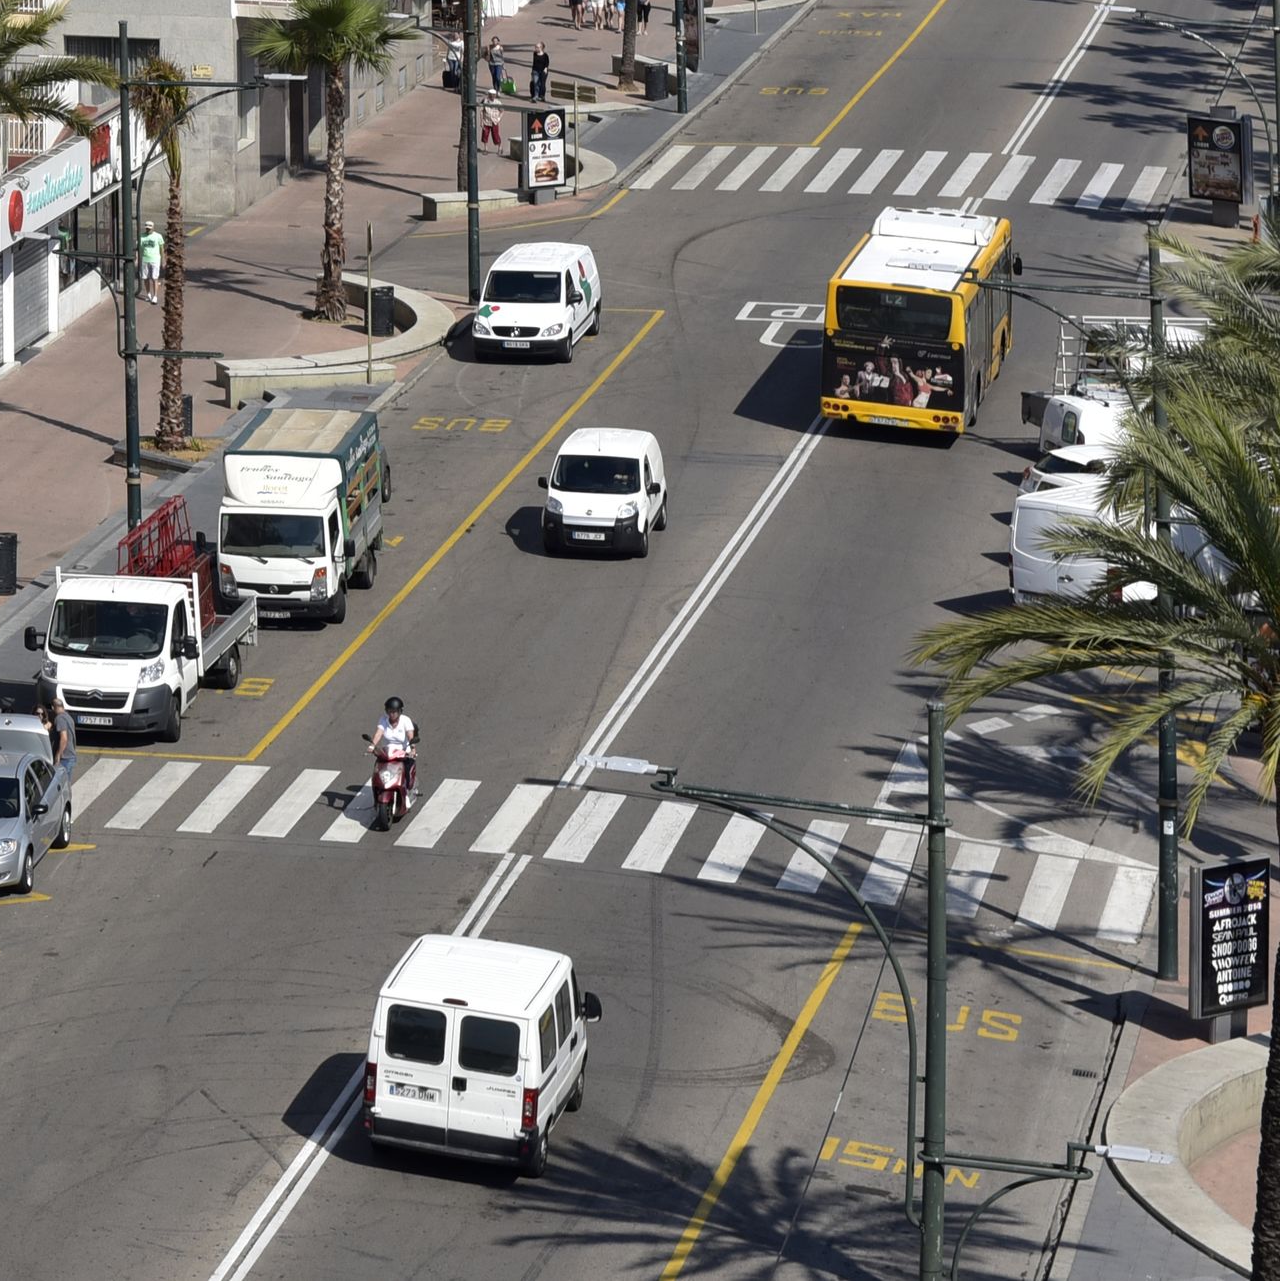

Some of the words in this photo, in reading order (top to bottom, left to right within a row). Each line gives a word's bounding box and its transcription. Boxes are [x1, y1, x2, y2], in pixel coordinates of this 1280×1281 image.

[758, 87, 830, 95] BUS
[411, 416, 513, 432] BUS
[1209, 906, 1242, 919] SUMMER
[1213, 914, 1257, 932] AFROJACK
[1212, 930, 1235, 943] SEAN
[1235, 926, 1258, 938] PAUL
[1212, 952, 1257, 971] SHOWTEK
[1216, 966, 1252, 983] ANTOINE
[396, 1085, 416, 1099] 5273
